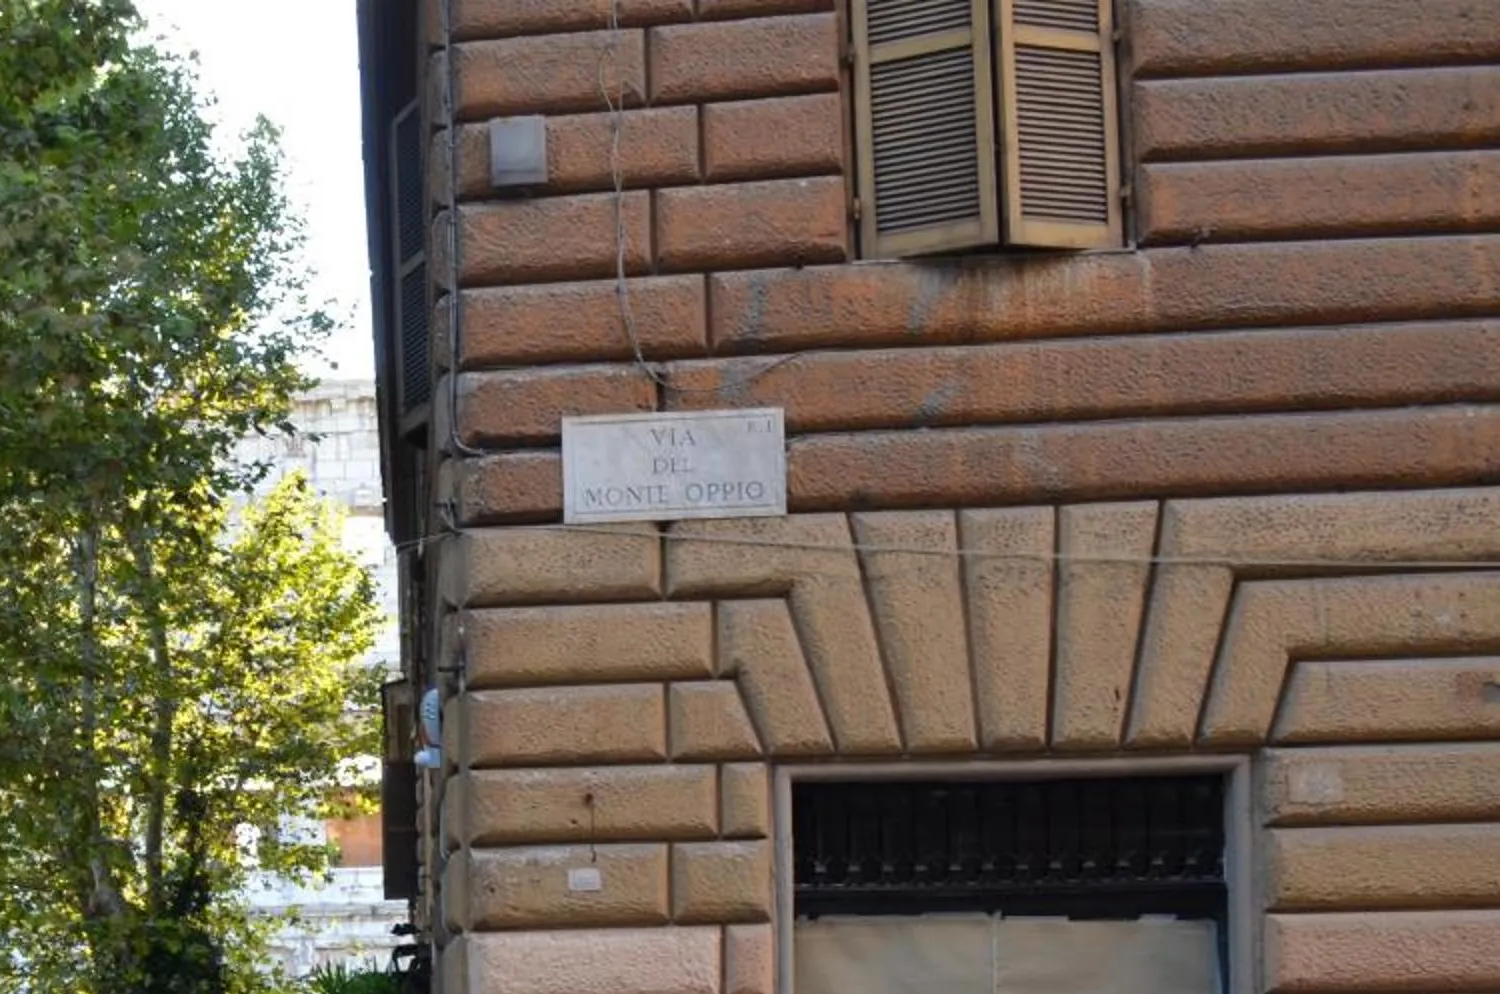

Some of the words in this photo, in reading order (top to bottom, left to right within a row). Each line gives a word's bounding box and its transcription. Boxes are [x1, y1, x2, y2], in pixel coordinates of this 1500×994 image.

[649, 427, 697, 447] VIA
[652, 457, 694, 475] DEL
[584, 484, 669, 507] MONTE
[685, 480, 765, 502] OPPIO
